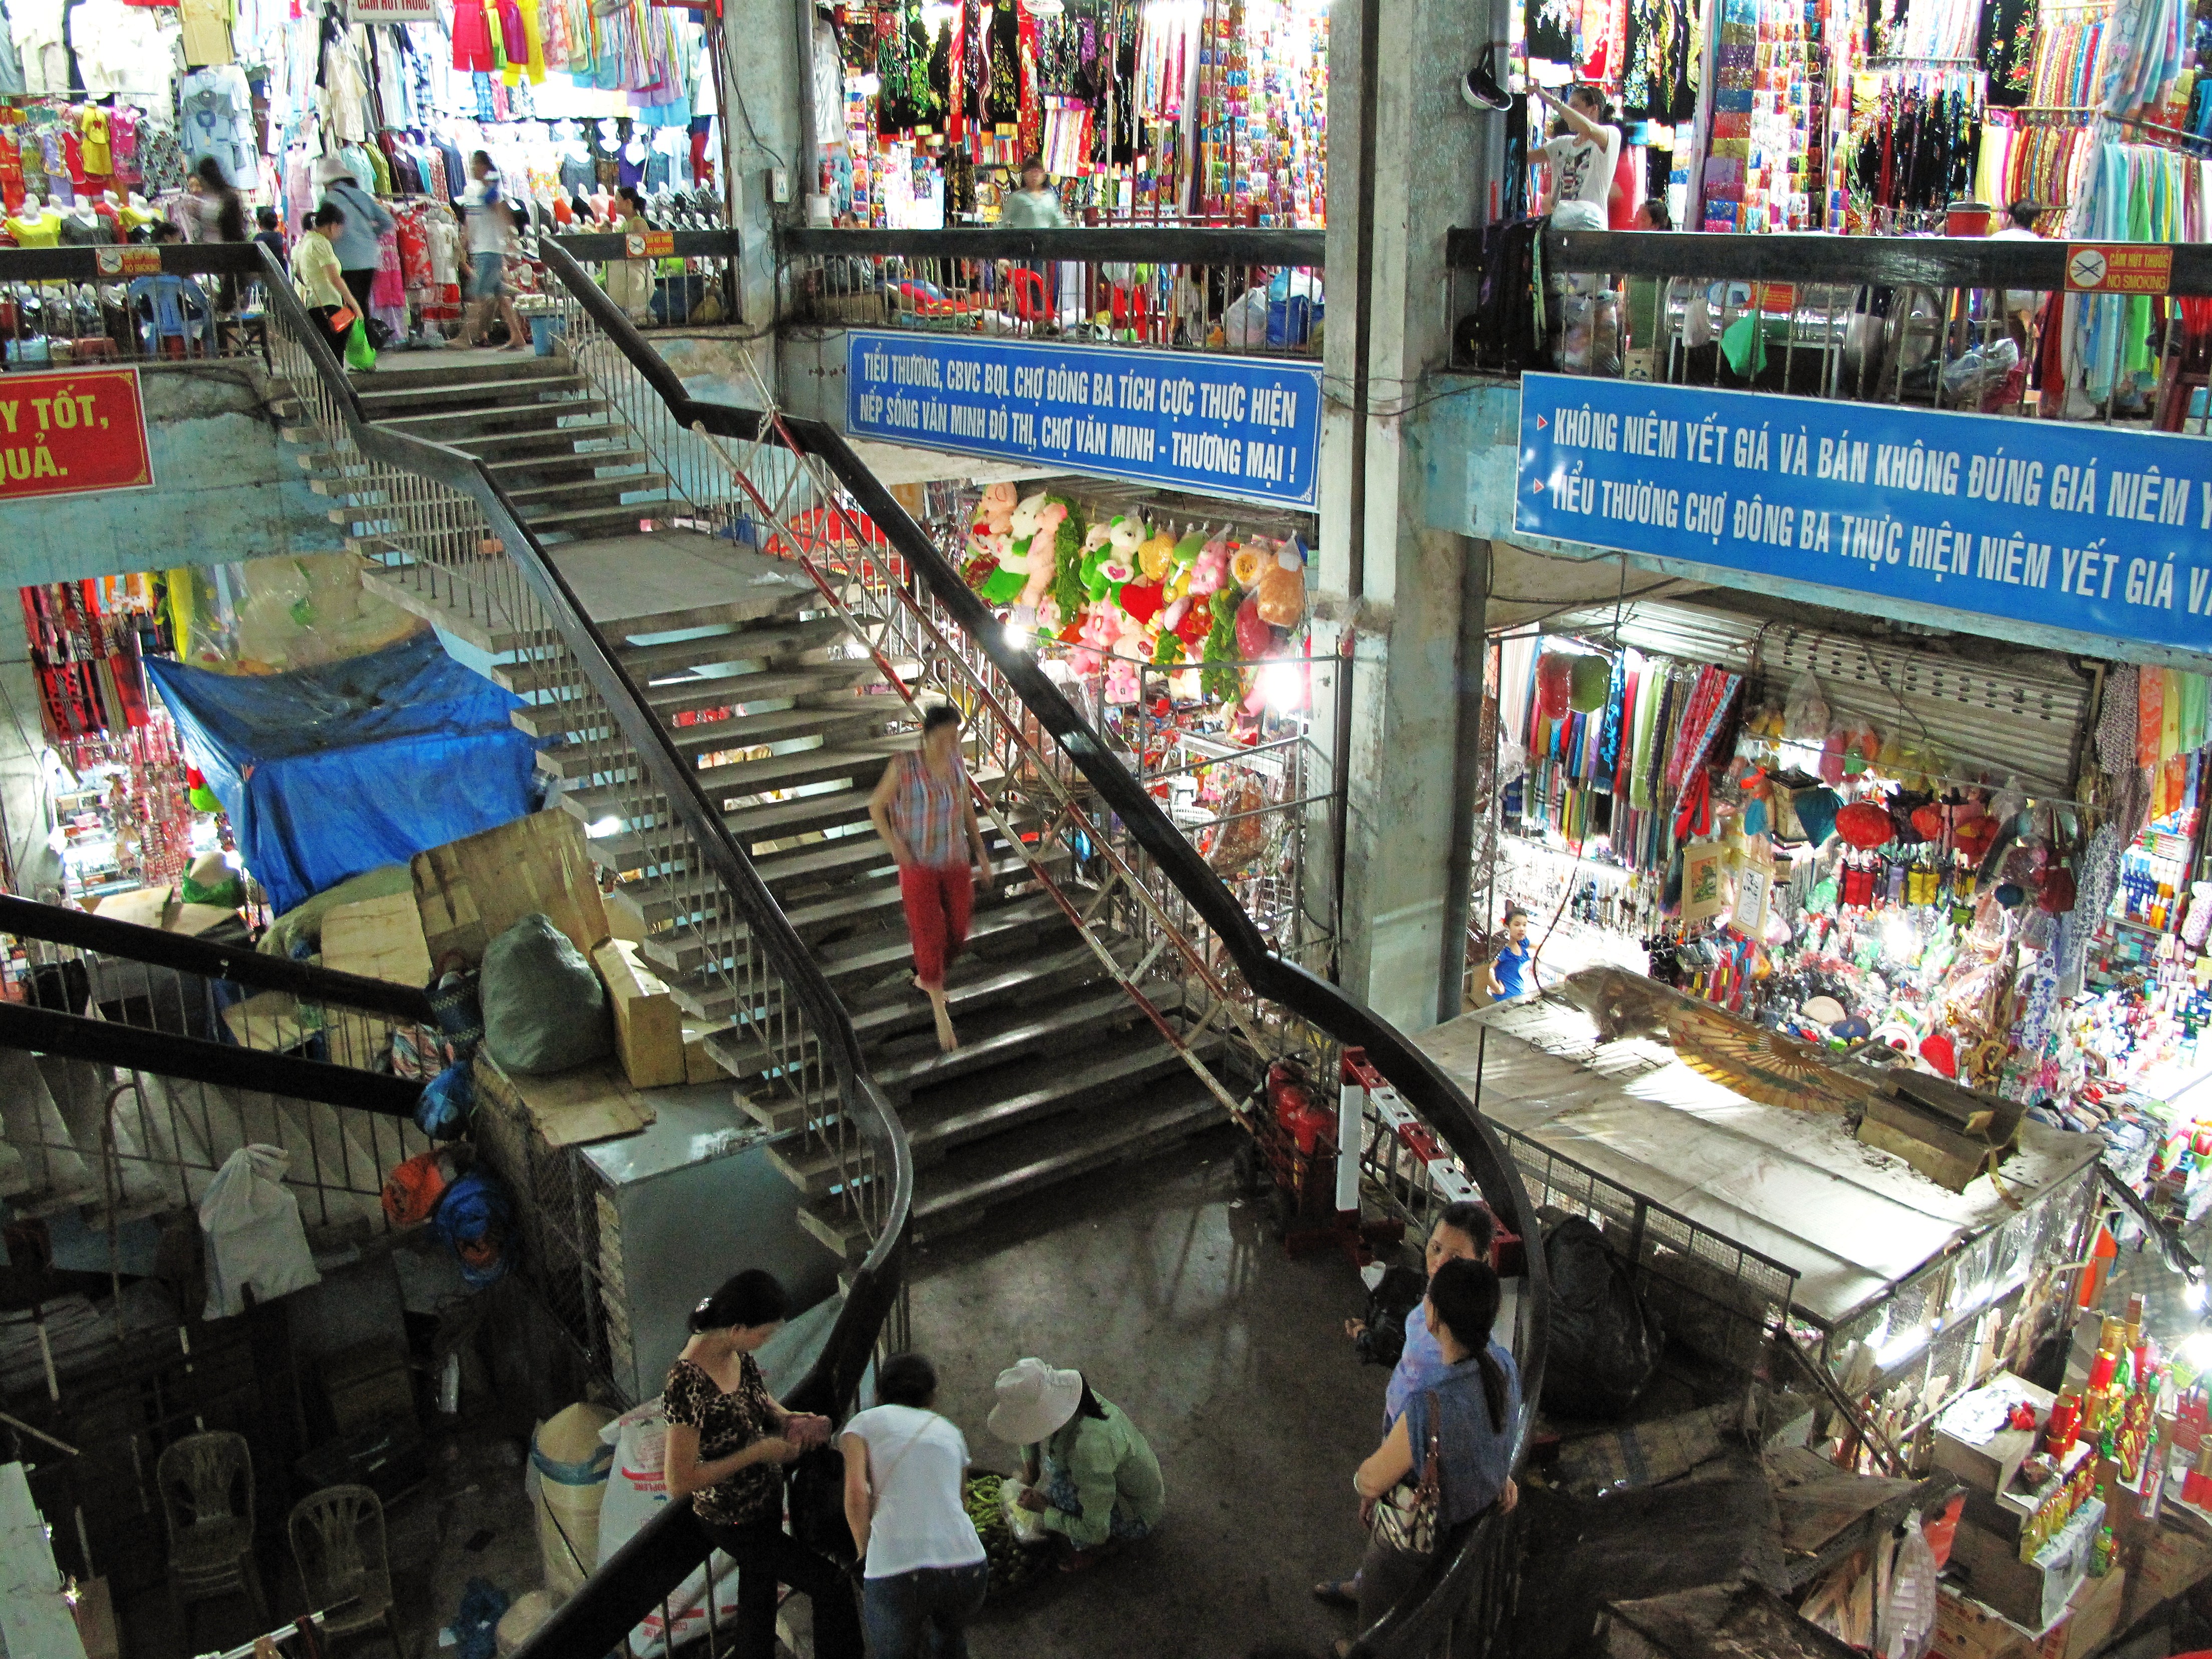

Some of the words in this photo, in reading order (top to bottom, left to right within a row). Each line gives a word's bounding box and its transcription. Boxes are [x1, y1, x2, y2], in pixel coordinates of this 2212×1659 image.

[2107, 274, 2120, 288] NO
[2123, 275, 2167, 289] SMOKING
[31, 384, 110, 430] TỐT,
[864, 342, 889, 384] TIỂU
[892, 354, 943, 393] THƯƠNG,
[946, 359, 982, 393] CBVC
[985, 363, 1010, 399] BQL
[1014, 365, 1045, 407] CHỢ
[1046, 363, 1089, 405] ĐÔNG
[1092, 373, 1114, 408] BA
[1119, 369, 1156, 412] TÍCH
[1160, 377, 1196, 423] CỰC
[1200, 382, 1246, 429] THỰC
[1250, 382, 1297, 436] HIỆN
[0, 432, 69, 485] UẢ.
[860, 385, 883, 424] NẾP
[886, 388, 919, 430] SỐNG
[922, 396, 948, 434] VĂN
[951, 404, 986, 439] MINH
[989, 404, 1008, 441] ĐÔ
[1012, 412, 1037, 452] THỊ,
[1041, 415, 1073, 457] CHỢ
[1076, 414, 1107, 456] VĂN
[1111, 424, 1156, 463] MINH
[1171, 431, 1242, 476] THƯƠNG
[1246, 441, 1284, 488] MẠI
[1553, 403, 1618, 452] KHÔNG
[1622, 410, 1678, 459] NIÊM
[1686, 412, 1728, 465] YẾT
[1734, 421, 1769, 471] GIÁ
[1780, 425, 1808, 476] VÀ
[1817, 429, 1869, 483] BÁN
[1874, 439, 1960, 496] KHÔNG
[1968, 447, 2044, 506] ĐÚNG
[2050, 457, 2098, 514] GIÁ
[2106, 465, 2191, 526] NIÊM
[1552, 460, 1595, 516] TIỂU
[1602, 478, 1680, 528] THƯƠNG
[1685, 491, 1728, 545] CHỢ
[1733, 494, 1794, 547] ĐÔNG
[1799, 509, 1830, 553] BA
[1841, 513, 1903, 572] THỰC
[1907, 520, 1972, 583] HIỆN
[1977, 531, 2052, 589] NIÊM
[2061, 537, 2120, 600] YẾT
[2125, 551, 2176, 610] GIÁ
[2188, 567, 2212, 617] V
